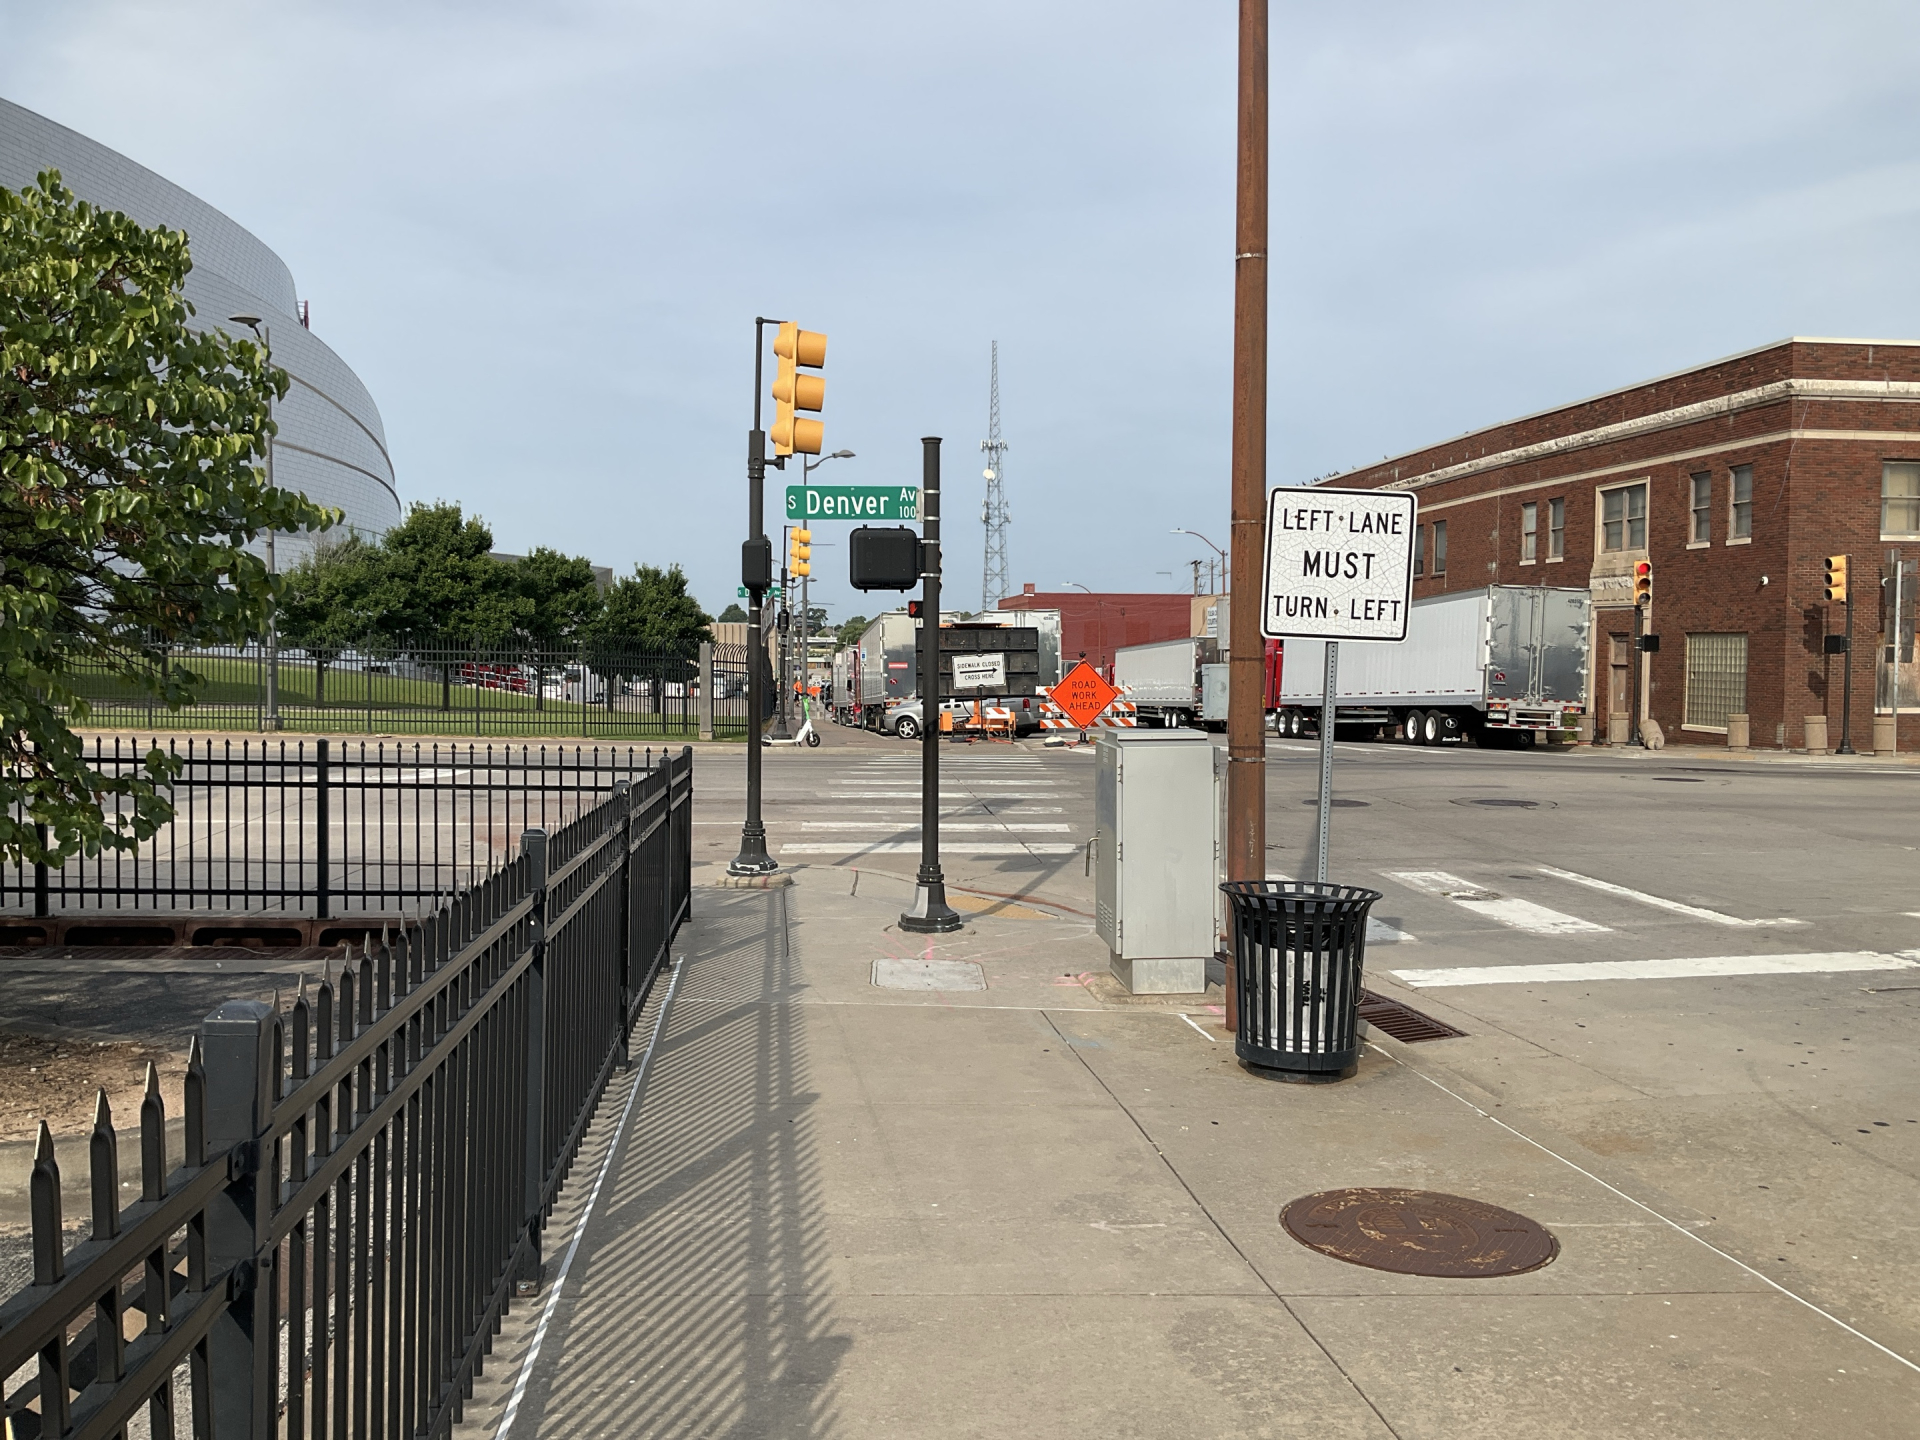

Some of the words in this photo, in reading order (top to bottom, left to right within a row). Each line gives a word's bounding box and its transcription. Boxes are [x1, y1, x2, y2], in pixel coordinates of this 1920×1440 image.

[899, 487, 916, 502] Av
[787, 495, 796, 510] S
[806, 490, 889, 515] Denver
[899, 505, 916, 519] 100
[1283, 508, 1334, 532] LEFT
[1349, 511, 1403, 535] LANE
[1303, 550, 1376, 580] MUST
[1273, 595, 1328, 619] TURN
[1350, 598, 1401, 622] LEFT
[1071, 680, 1097, 689] ROAD
[1071, 691, 1097, 700] WORK
[1068, 701, 1101, 711] AHEAD
